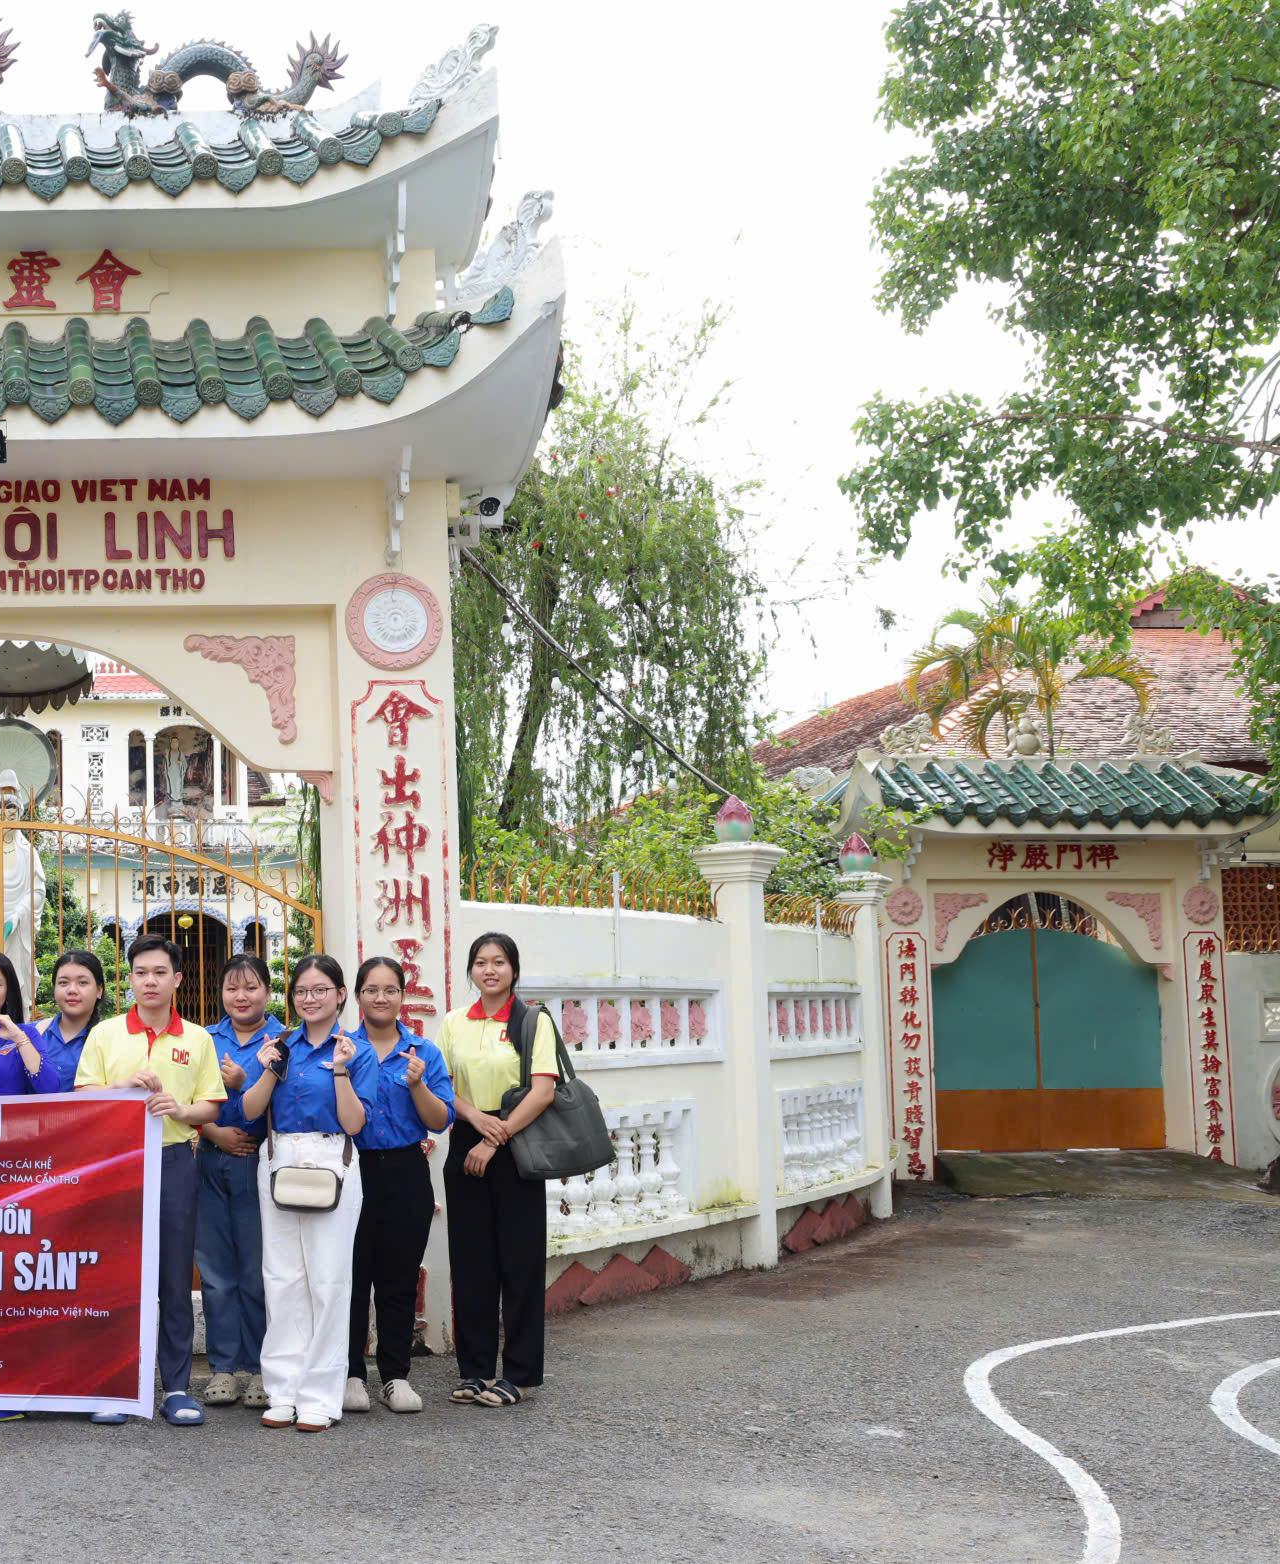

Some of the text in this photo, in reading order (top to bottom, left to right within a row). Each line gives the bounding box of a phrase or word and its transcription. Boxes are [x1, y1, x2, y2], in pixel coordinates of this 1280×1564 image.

[71, 478, 138, 504] VIET
[148, 478, 211, 502] NAM
[104, 509, 235, 561] LINH
[15, 1158, 32, 1169] CÁI
[35, 1155, 52, 1170] KHẾ
[10, 1174, 33, 1184] NAM
[58, 1174, 80, 1185] THƠ
[5, 1305, 26, 1317] Chủ
[28, 1306, 59, 1318] Nghĩa
[61, 1306, 82, 1318] Việt
[84, 1307, 110, 1317] Nam
